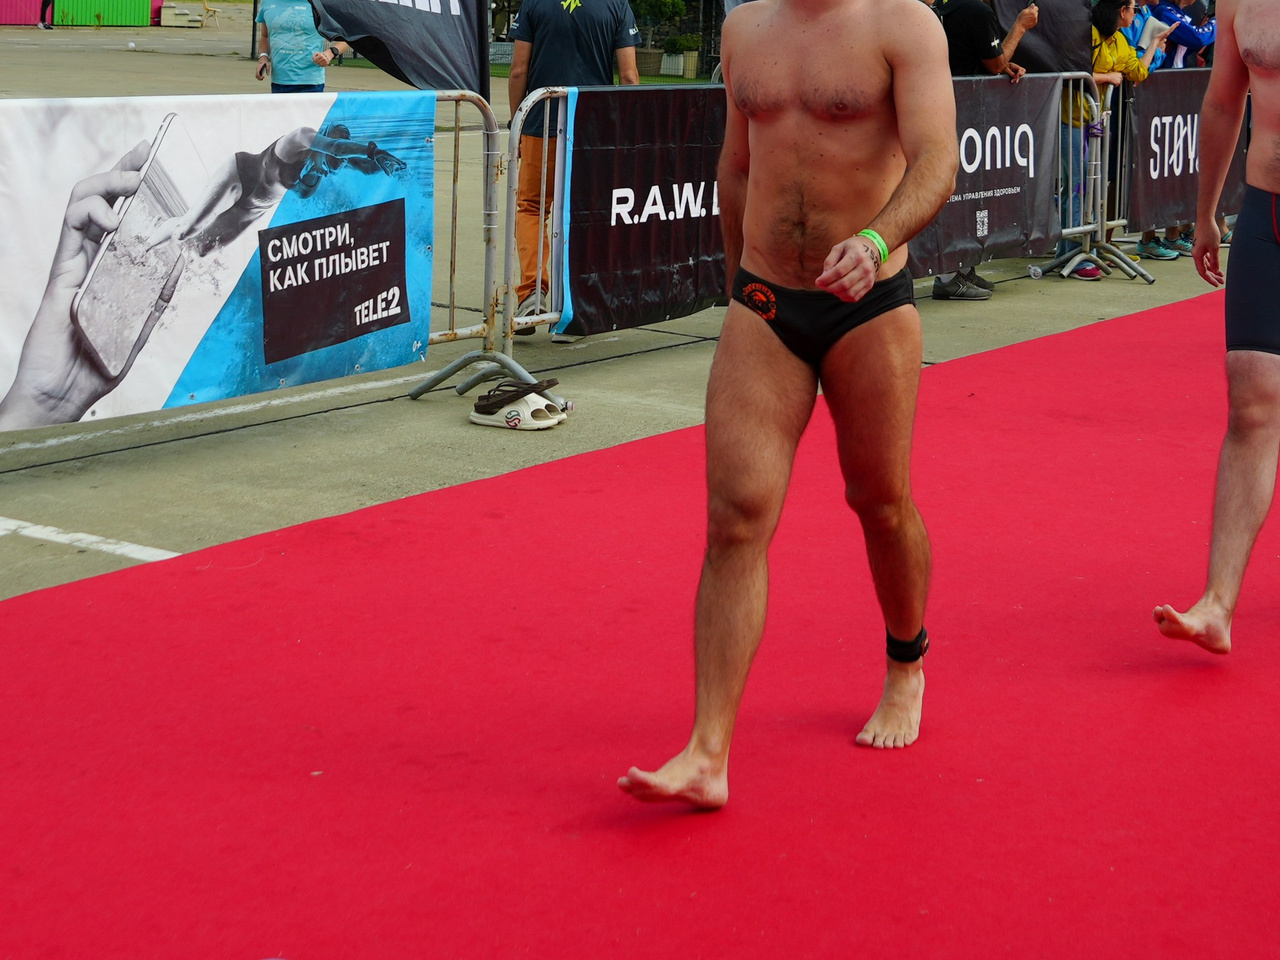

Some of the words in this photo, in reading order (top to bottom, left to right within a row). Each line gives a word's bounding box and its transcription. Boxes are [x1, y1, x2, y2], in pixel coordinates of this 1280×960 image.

[959, 123, 1034, 179] oniq
[1149, 113, 1200, 180] STØY
[947, 193, 962, 203] ТЕМА
[963, 189, 994, 201] УПРАВЛЕНИЯ
[994, 186, 1021, 197] ЗДОРОВЬЕМ
[267, 222, 355, 263] СМОТРИ,
[269, 261, 311, 293] КАК
[314, 241, 391, 281] ПЛЫВЕТ
[354, 285, 402, 326] TELE2
